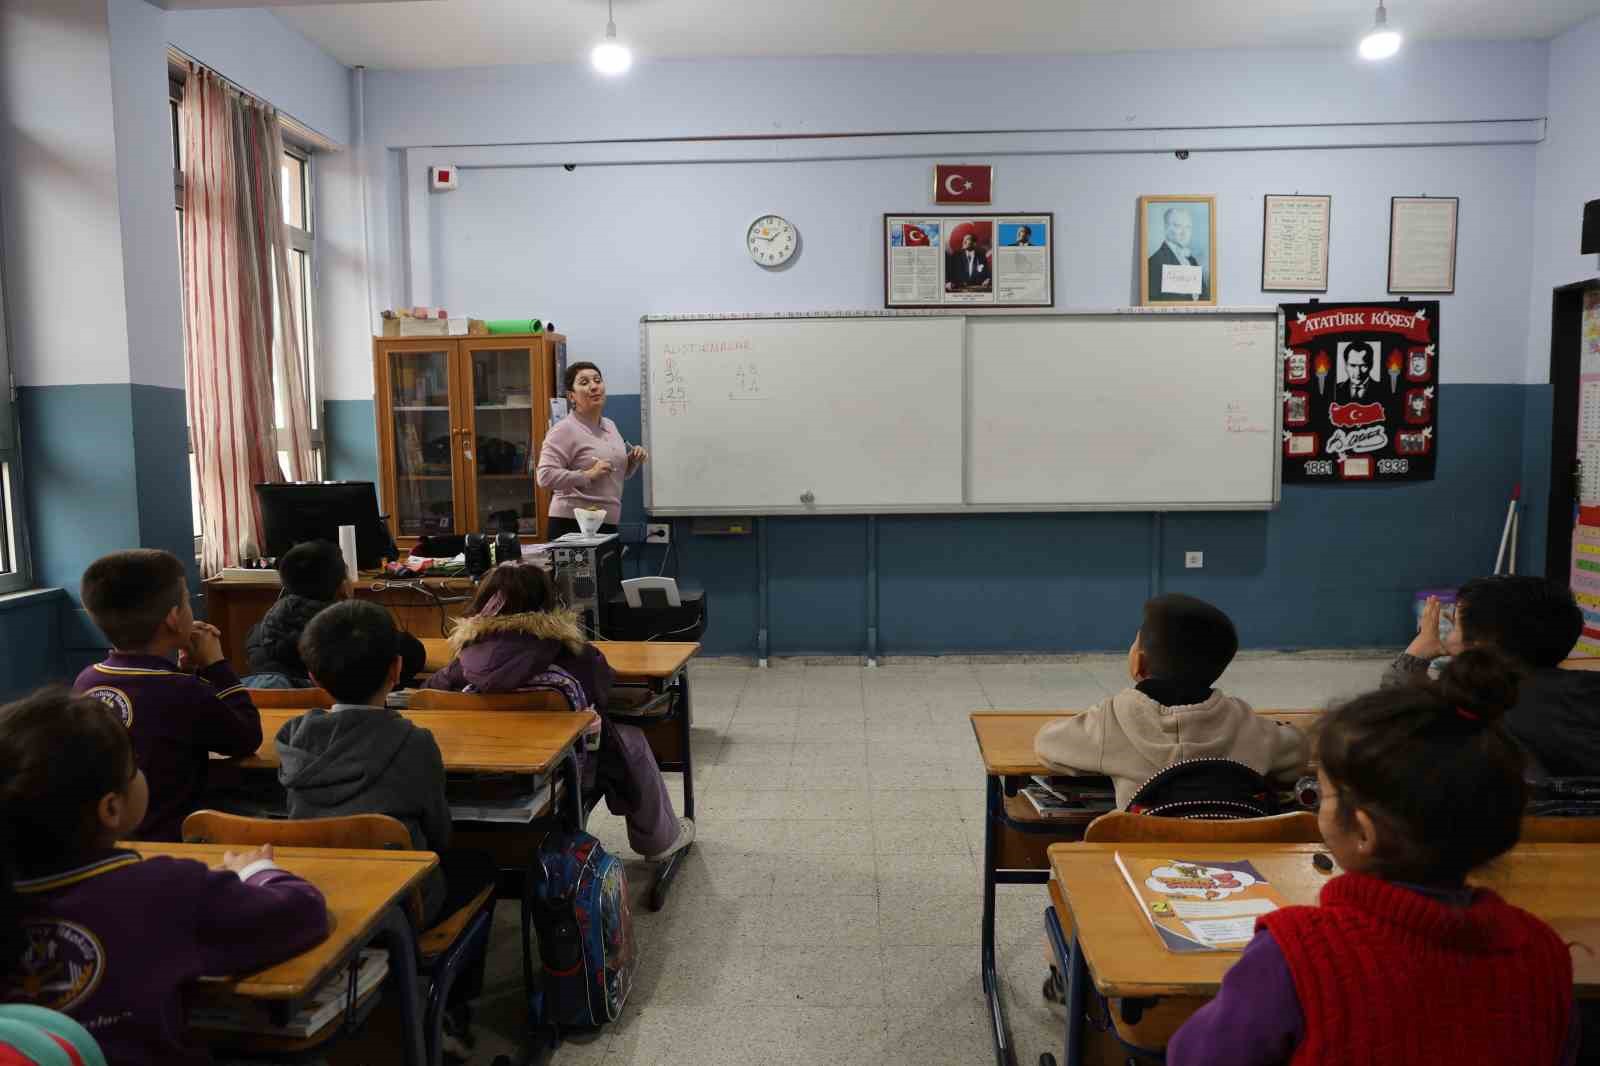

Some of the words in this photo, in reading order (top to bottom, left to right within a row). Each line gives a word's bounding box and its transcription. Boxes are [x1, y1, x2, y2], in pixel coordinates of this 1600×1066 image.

[1304, 312, 1366, 333] ATATÜRK
[1371, 310, 1416, 330] KÖŞESİ
[1304, 460, 1334, 475] 1881
[1377, 459, 1409, 474] 1938
